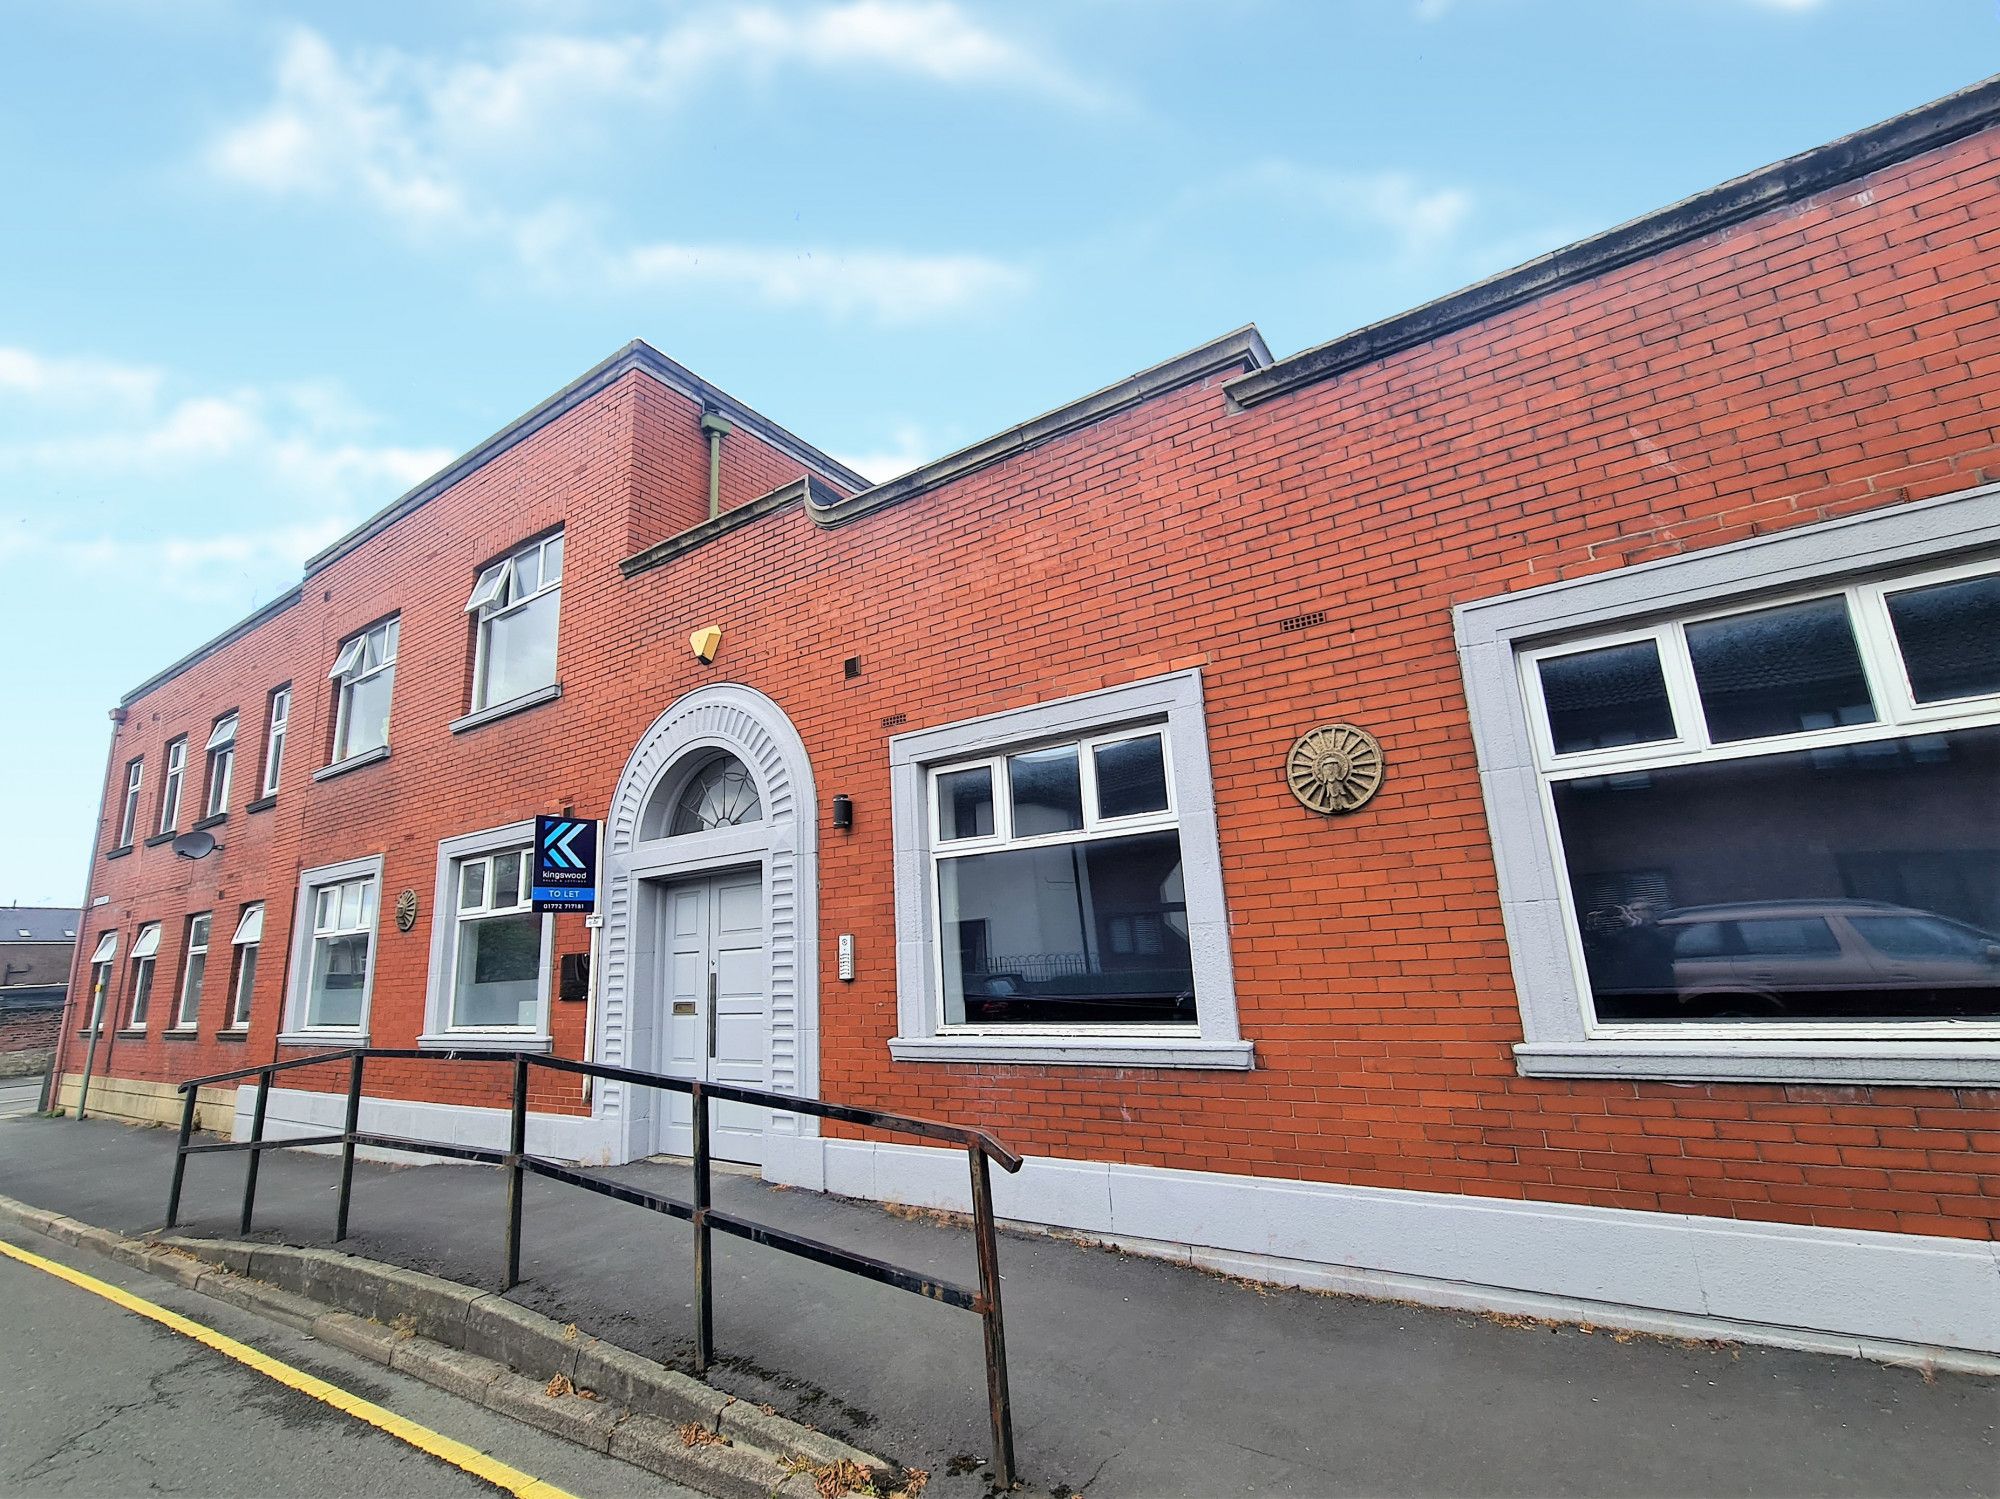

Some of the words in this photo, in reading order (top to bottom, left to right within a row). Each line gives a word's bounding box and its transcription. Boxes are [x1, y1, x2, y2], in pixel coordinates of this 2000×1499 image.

[542, 870, 587, 880] kingswood
[549, 890, 561, 898] TO
[563, 890, 580, 898] LET
